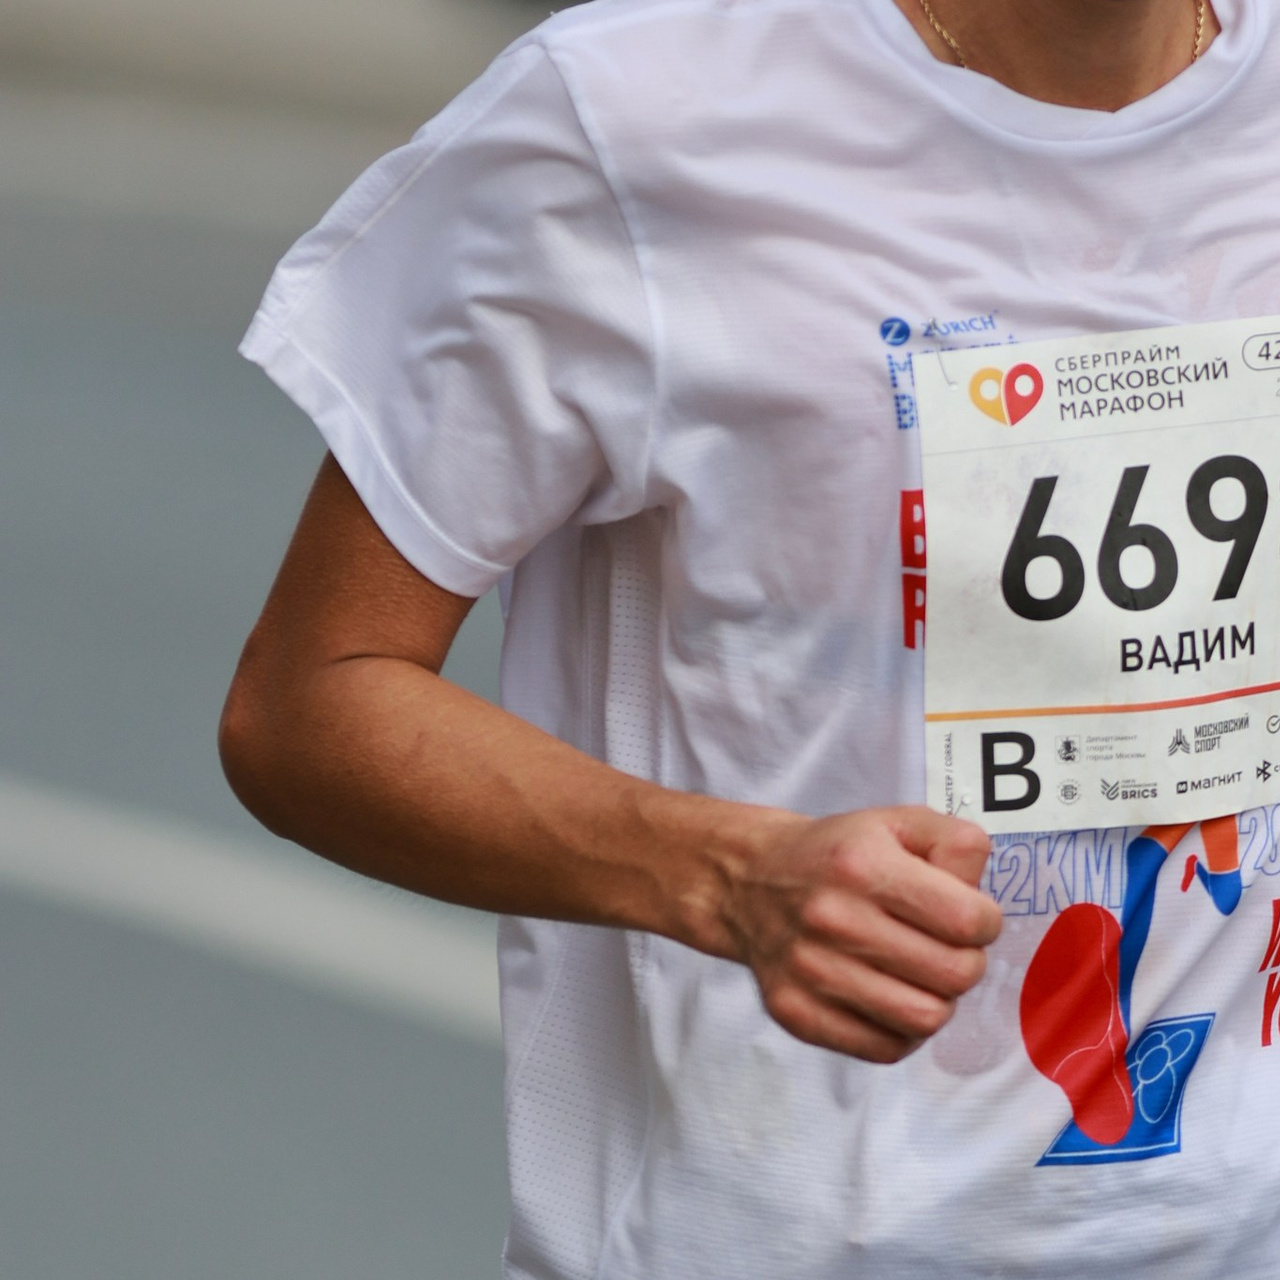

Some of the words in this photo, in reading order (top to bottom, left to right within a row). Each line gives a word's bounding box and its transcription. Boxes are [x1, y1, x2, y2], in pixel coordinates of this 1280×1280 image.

[921, 314, 997, 338] ZURICH
[1054, 344, 1180, 372] СБЕРПРАЙМ
[1057, 357, 1229, 397] МОСКОВСКИЙ
[1059, 389, 1184, 421] МАРАФОН
[1119, 622, 1256, 674] ВАДИМ
[1193, 712, 1250, 739] МОСКОВСКИЙ
[1194, 735, 1221, 753] СПОРТ
[1121, 788, 1158, 800] BRICS
